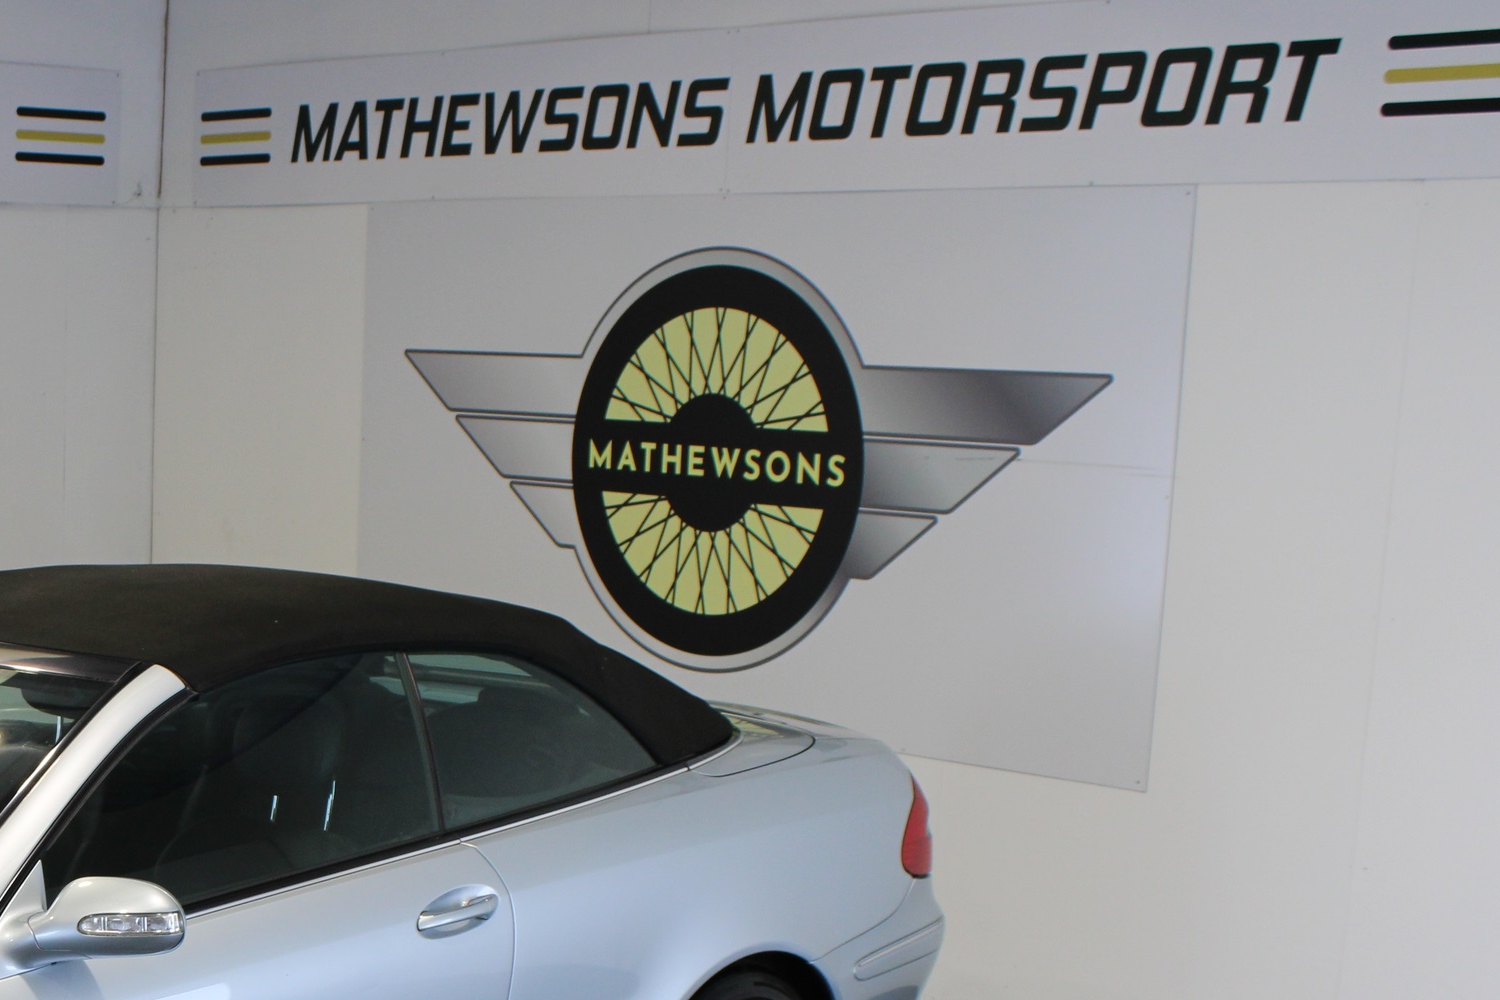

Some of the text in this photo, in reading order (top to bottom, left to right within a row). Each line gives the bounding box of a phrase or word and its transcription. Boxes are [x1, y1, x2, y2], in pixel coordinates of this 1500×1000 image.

[291, 38, 1341, 163] MATHEWSONS MOTORSPORT
[589, 440, 845, 486] MATHEWSONS
